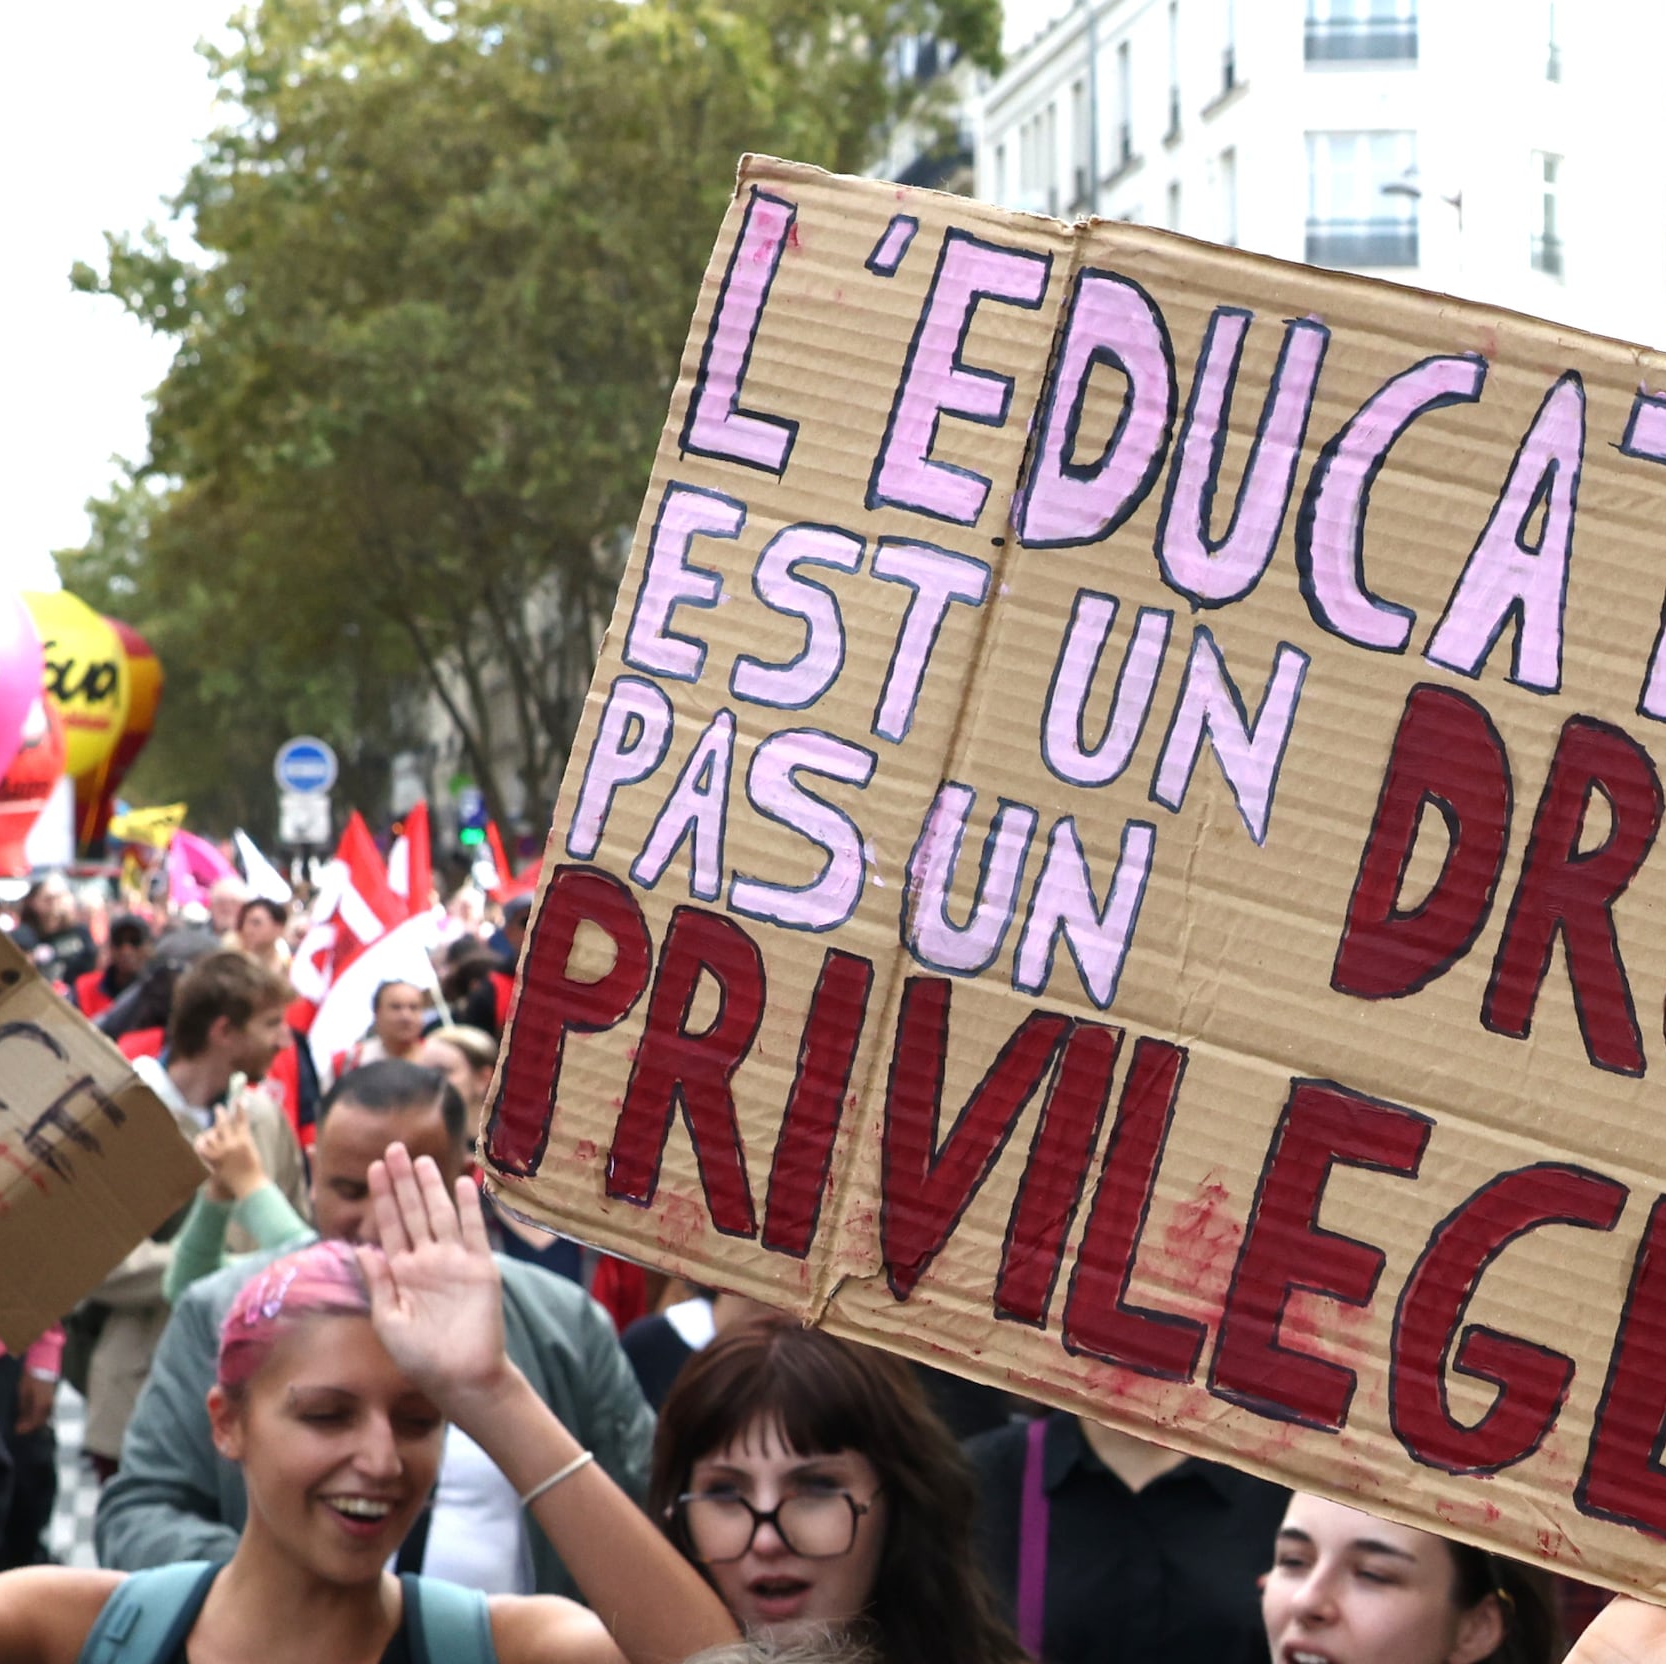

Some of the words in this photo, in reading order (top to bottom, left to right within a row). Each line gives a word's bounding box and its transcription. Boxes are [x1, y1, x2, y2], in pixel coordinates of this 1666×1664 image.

[622, 480, 991, 743] EST
[1040, 588, 1311, 846] UN
[563, 674, 880, 933] PAS
[903, 780, 1158, 1009] UN
